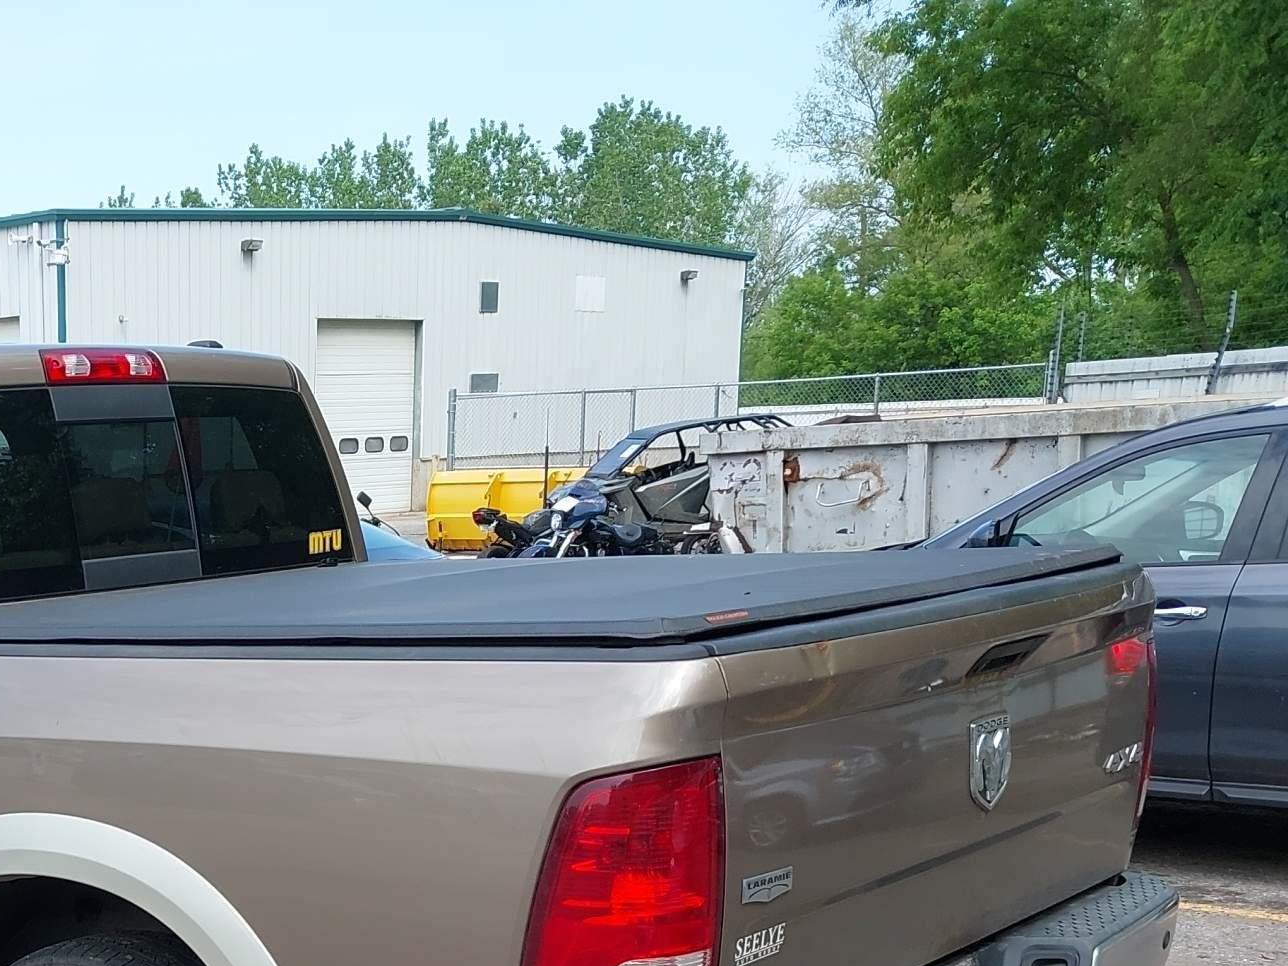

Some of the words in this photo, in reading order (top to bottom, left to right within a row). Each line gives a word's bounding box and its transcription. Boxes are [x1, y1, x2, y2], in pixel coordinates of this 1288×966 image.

[309, 528, 342, 555] MTU
[976, 716, 1009, 732] DODGE
[747, 872, 792, 890] LARAMIE
[734, 922, 787, 959] SEELYE
